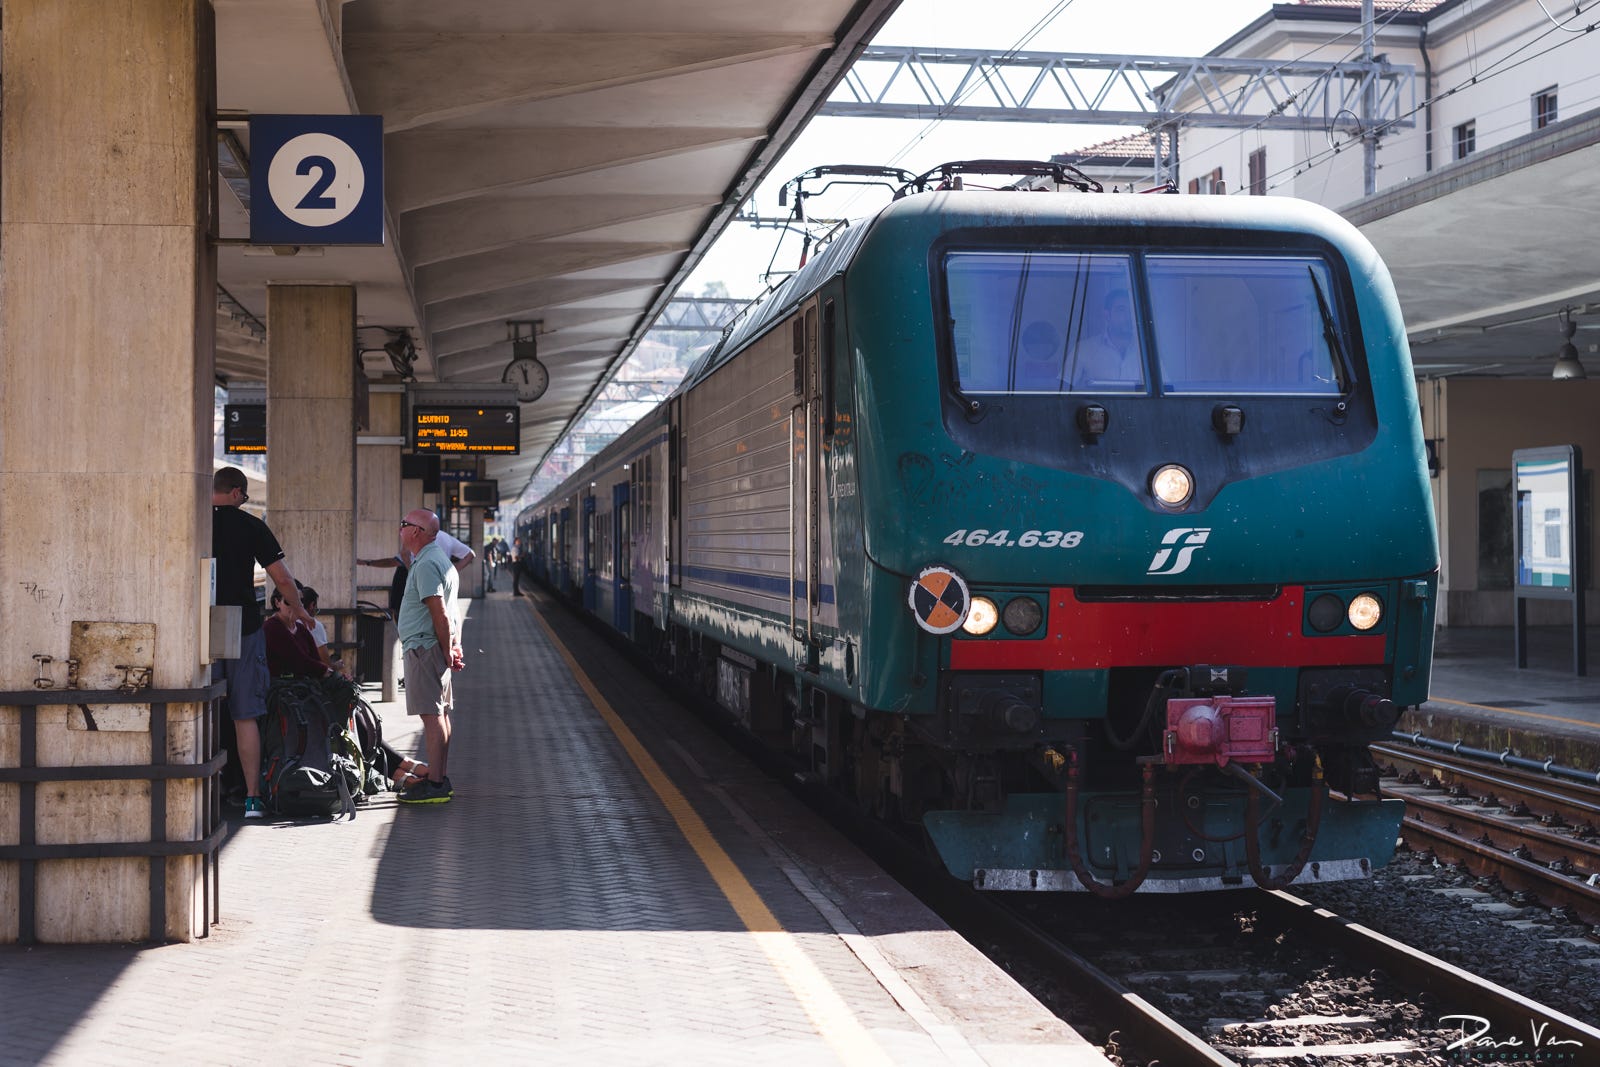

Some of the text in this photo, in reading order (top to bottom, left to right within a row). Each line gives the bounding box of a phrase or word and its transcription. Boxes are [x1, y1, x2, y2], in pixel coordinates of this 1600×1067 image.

[295, 155, 336, 209] 2
[231, 411, 240, 422] 3
[505, 412, 514, 423] 2
[943, 529, 1084, 548] 464.638
